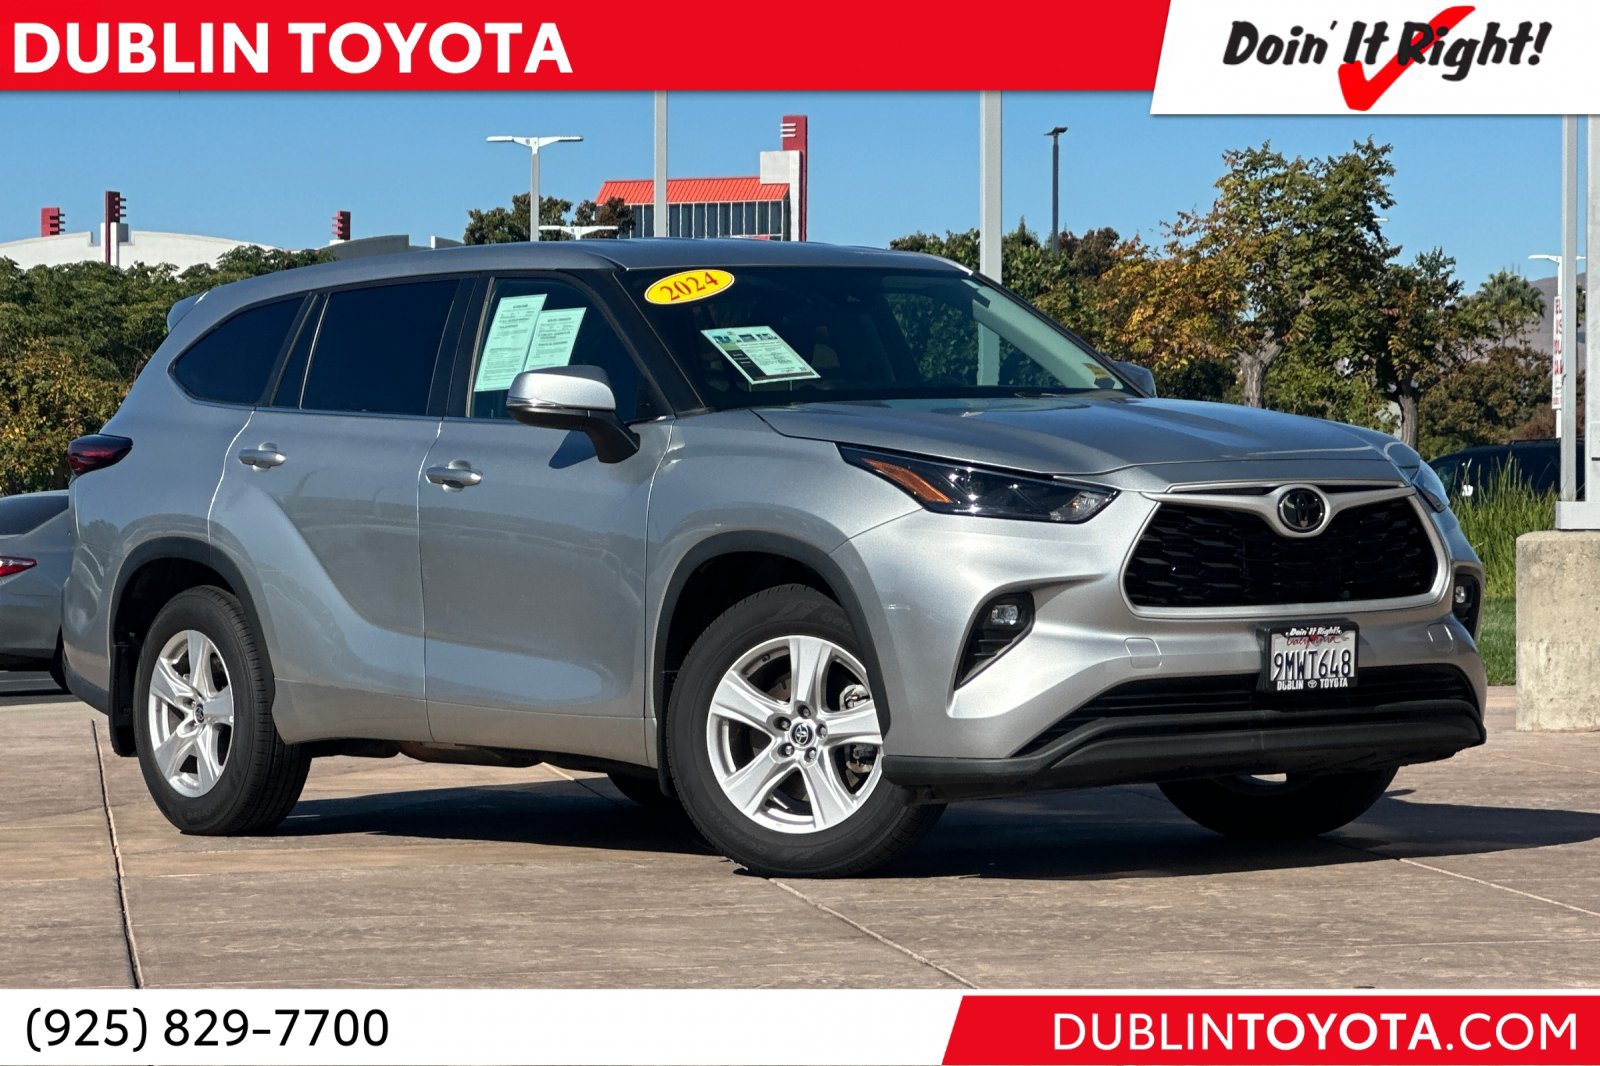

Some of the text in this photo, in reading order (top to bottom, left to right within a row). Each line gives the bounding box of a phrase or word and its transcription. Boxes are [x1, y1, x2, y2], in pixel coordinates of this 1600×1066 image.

[660, 272, 719, 301] 2024
[1274, 650, 1351, 680] 9MWT648
[1276, 677, 1348, 691] DUBLIN TOYOTA
